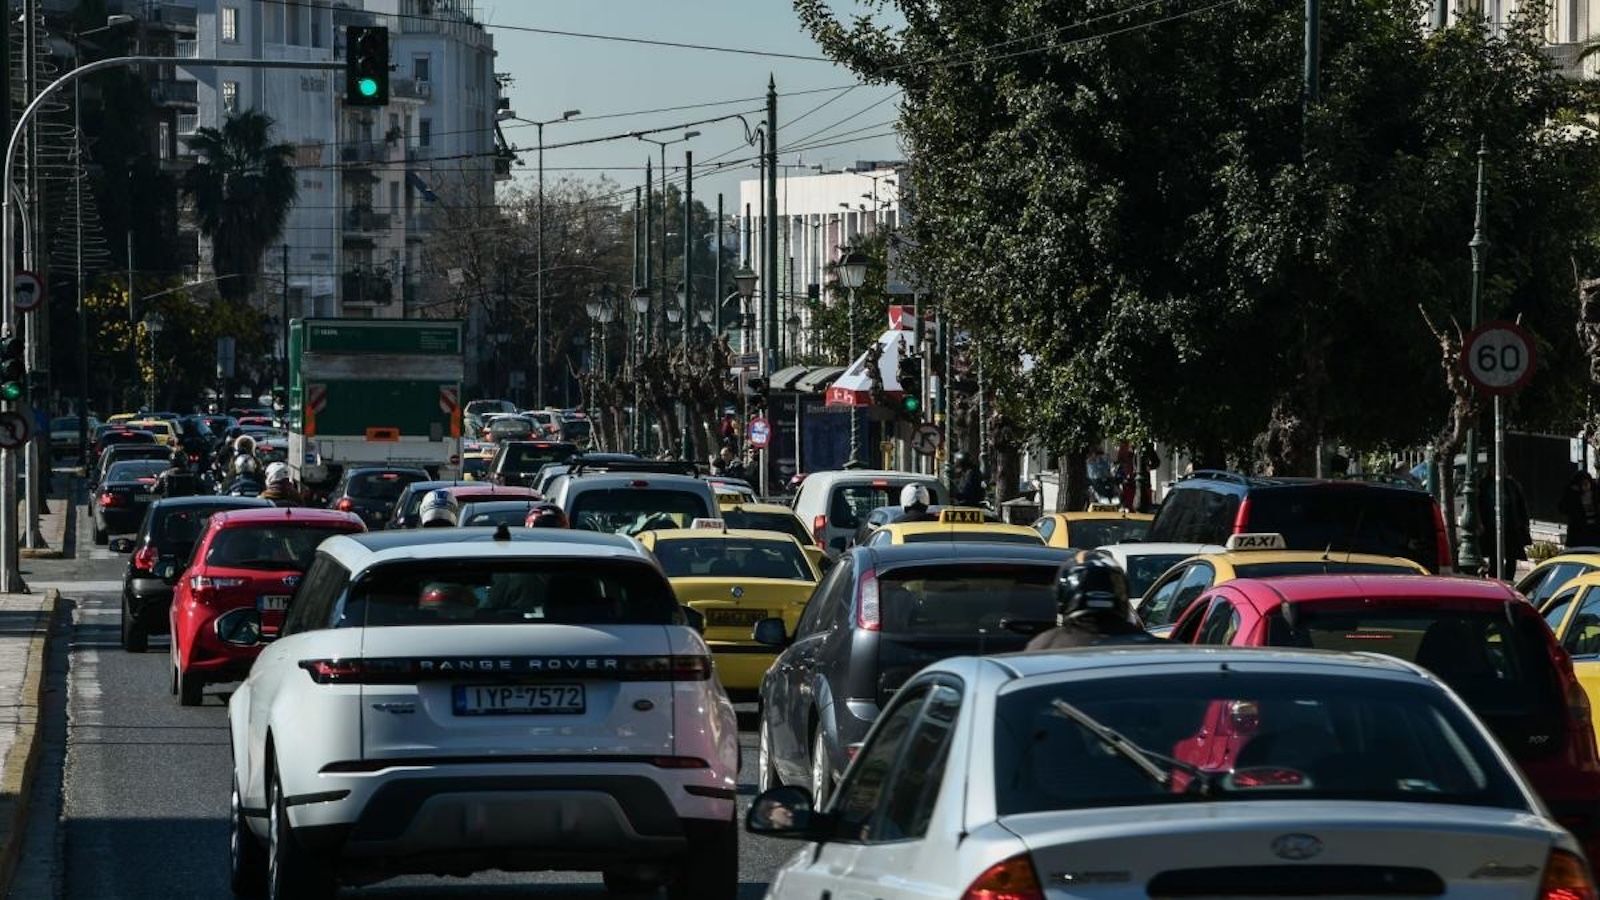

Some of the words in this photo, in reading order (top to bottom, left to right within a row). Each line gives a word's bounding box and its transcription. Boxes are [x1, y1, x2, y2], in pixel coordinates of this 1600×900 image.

[1478, 344, 1520, 372] 60
[946, 511, 978, 521] TAXI
[700, 520, 722, 529] TAXI
[1236, 535, 1276, 547] TAXI
[420, 659, 513, 671] RANGE
[528, 657, 619, 670] ROVER
